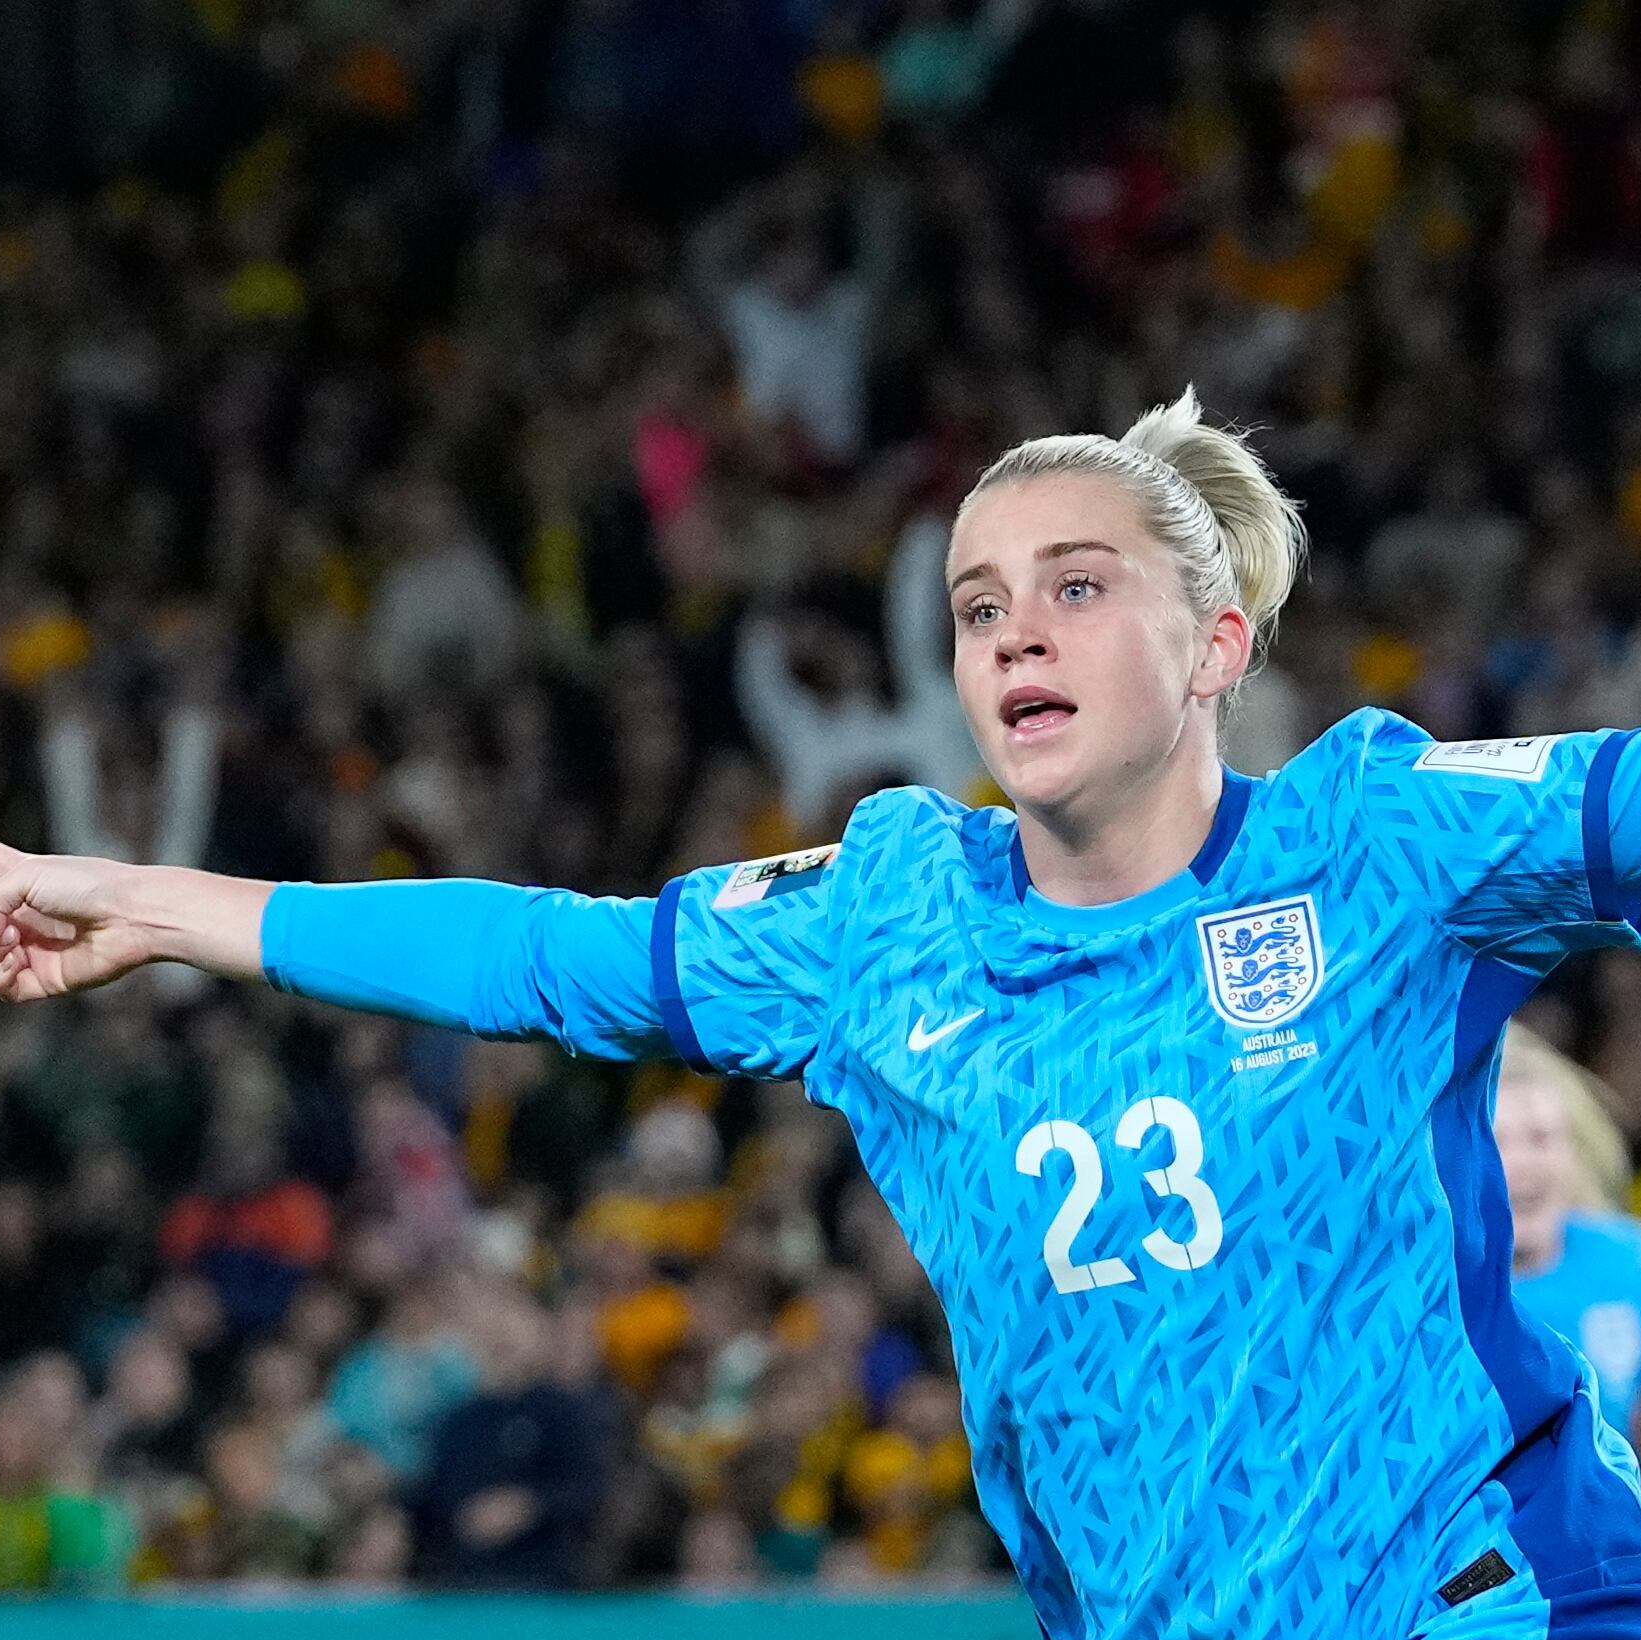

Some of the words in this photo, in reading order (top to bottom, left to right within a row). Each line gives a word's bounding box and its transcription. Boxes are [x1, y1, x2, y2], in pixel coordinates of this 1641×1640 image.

[1242, 1029, 1298, 1052] AUSTRALIA
[1230, 1059, 1244, 1073] 16
[1246, 1050, 1285, 1070] AUGUST
[1287, 1041, 1317, 1060] 2023
[1015, 1096, 1223, 1294] 23
